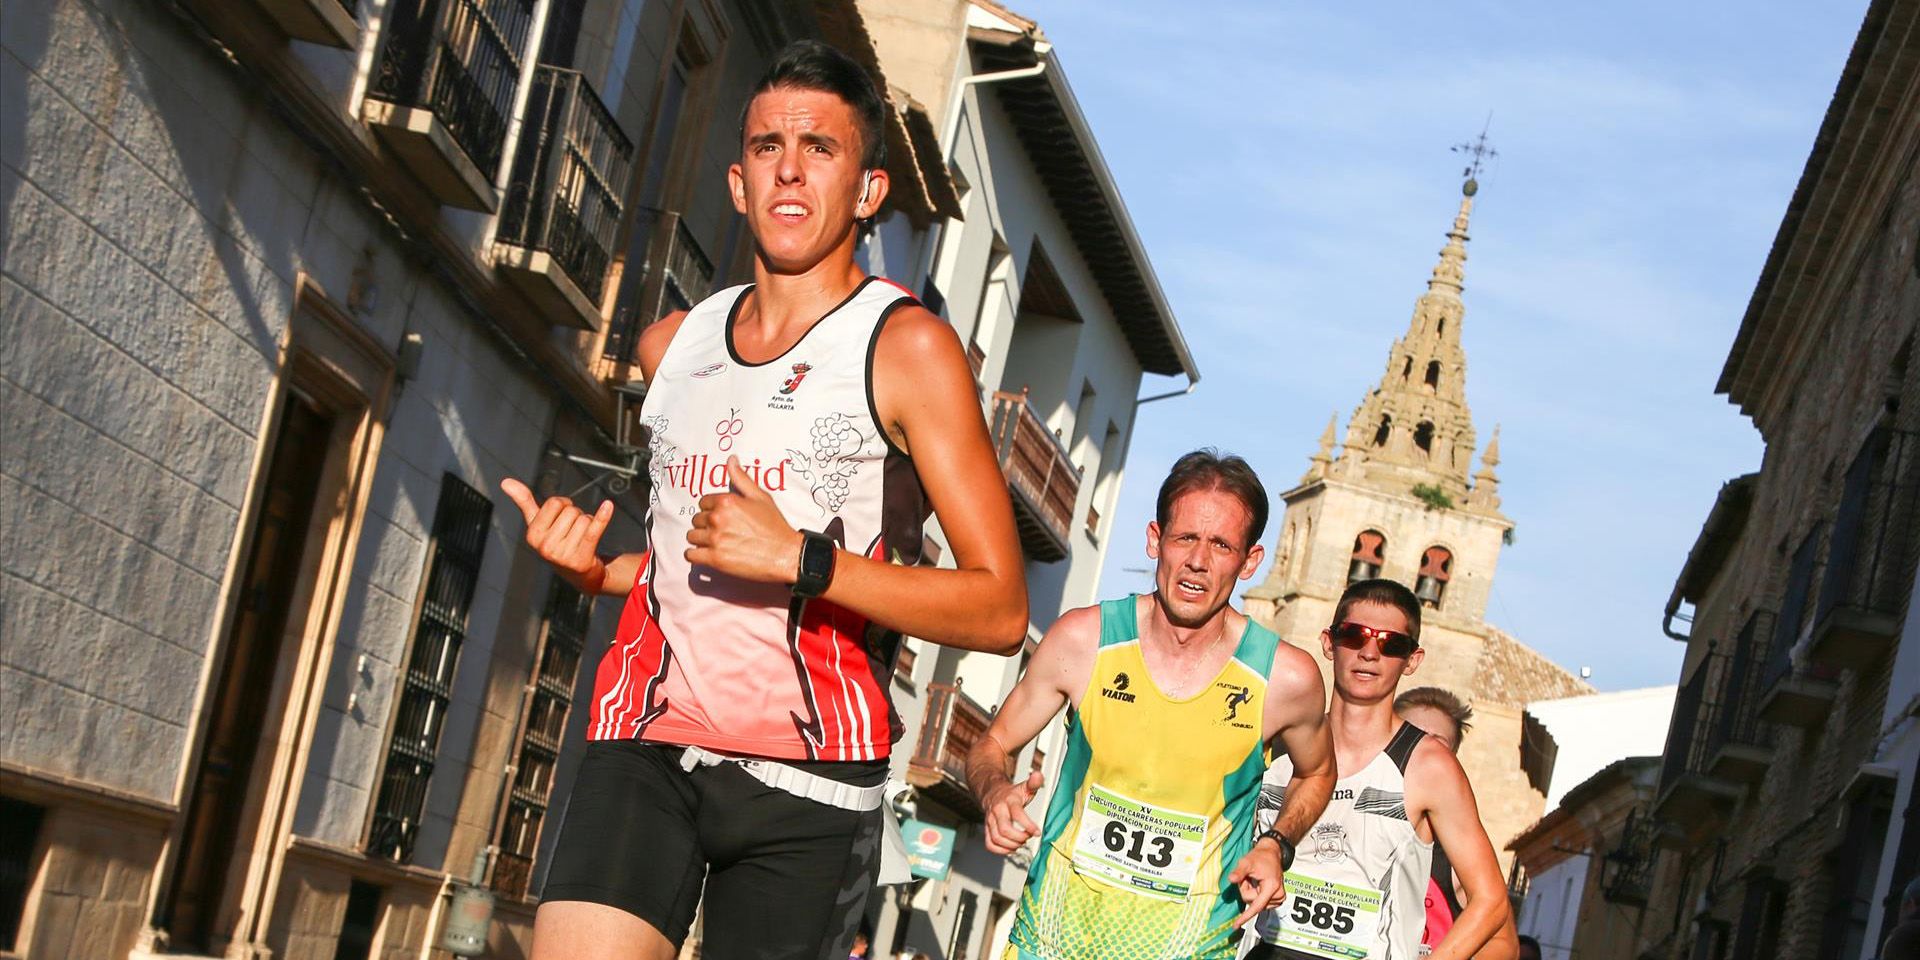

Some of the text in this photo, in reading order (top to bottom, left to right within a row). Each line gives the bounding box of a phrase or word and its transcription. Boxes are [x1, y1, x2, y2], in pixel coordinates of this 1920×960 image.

[664, 454, 791, 497] villaid
[1102, 687, 1136, 703] VIATOR
[1090, 795, 1204, 833] CIRCUITO DE CARRERAS POPULARES
[1141, 806, 1152, 814] XV
[1103, 820, 1175, 869] 613
[1144, 824, 1153, 832] DE
[1155, 827, 1181, 838] CUENCA
[1285, 878, 1304, 887] RCUITO
[1313, 886, 1344, 897] CARRERAS
[1345, 893, 1380, 905] POPULARES
[1338, 899, 1360, 908] CUENCA
[1291, 896, 1355, 934] 585
